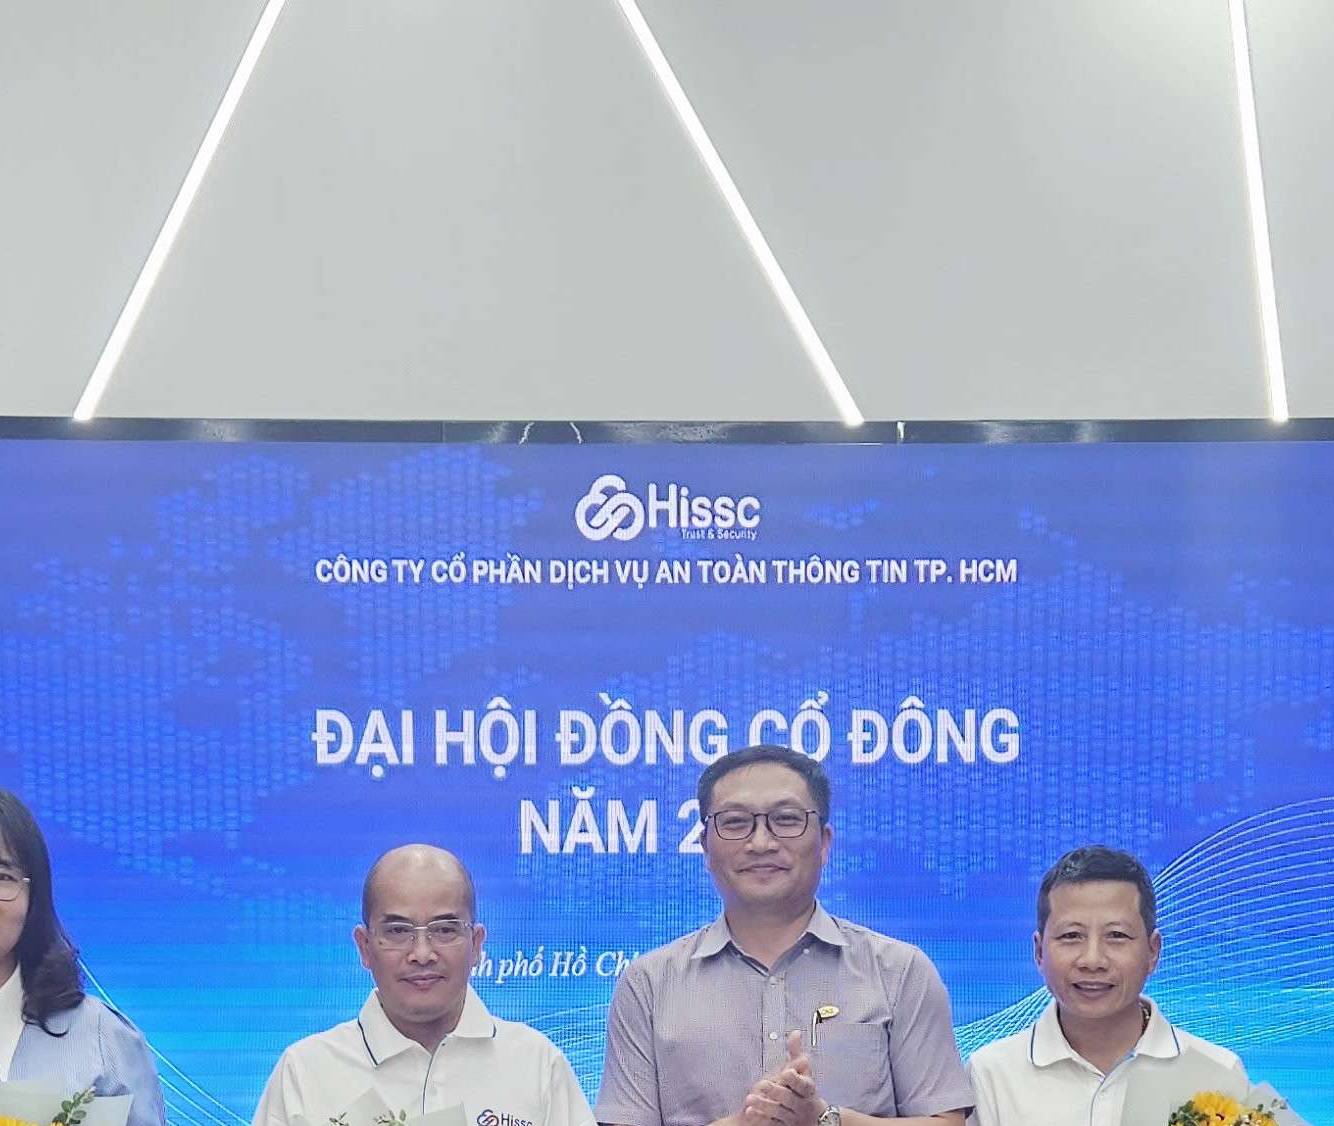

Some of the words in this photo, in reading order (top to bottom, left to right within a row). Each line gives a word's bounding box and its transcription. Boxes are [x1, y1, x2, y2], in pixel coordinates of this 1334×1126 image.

[648, 483, 760, 528] Hissc
[681, 528, 706, 540] Trust
[717, 528, 757, 541] Security
[317, 553, 388, 584] CÔNG
[393, 558, 425, 583] TY
[431, 551, 466, 584] CỔ
[472, 551, 542, 584] PHẦN
[549, 558, 609, 590] DỊCH
[613, 558, 648, 590] VỤ
[655, 559, 691, 584] AN
[697, 553, 766, 585] TOÀN
[771, 555, 861, 585] THÔNG
[866, 559, 907, 584] TIN
[914, 559, 953, 585] TP.
[959, 559, 1018, 584] HCM
[312, 708, 414, 778] ĐẠI
[435, 697, 536, 778] HỘI
[555, 693, 728, 765] ĐỒNG
[847, 696, 1020, 764] ĐÔNG
[519, 786, 658, 854] NĂM
[495, 945, 544, 984] phố
[548, 945, 588, 977] Hồ
[595, 951, 640, 977] Ch
